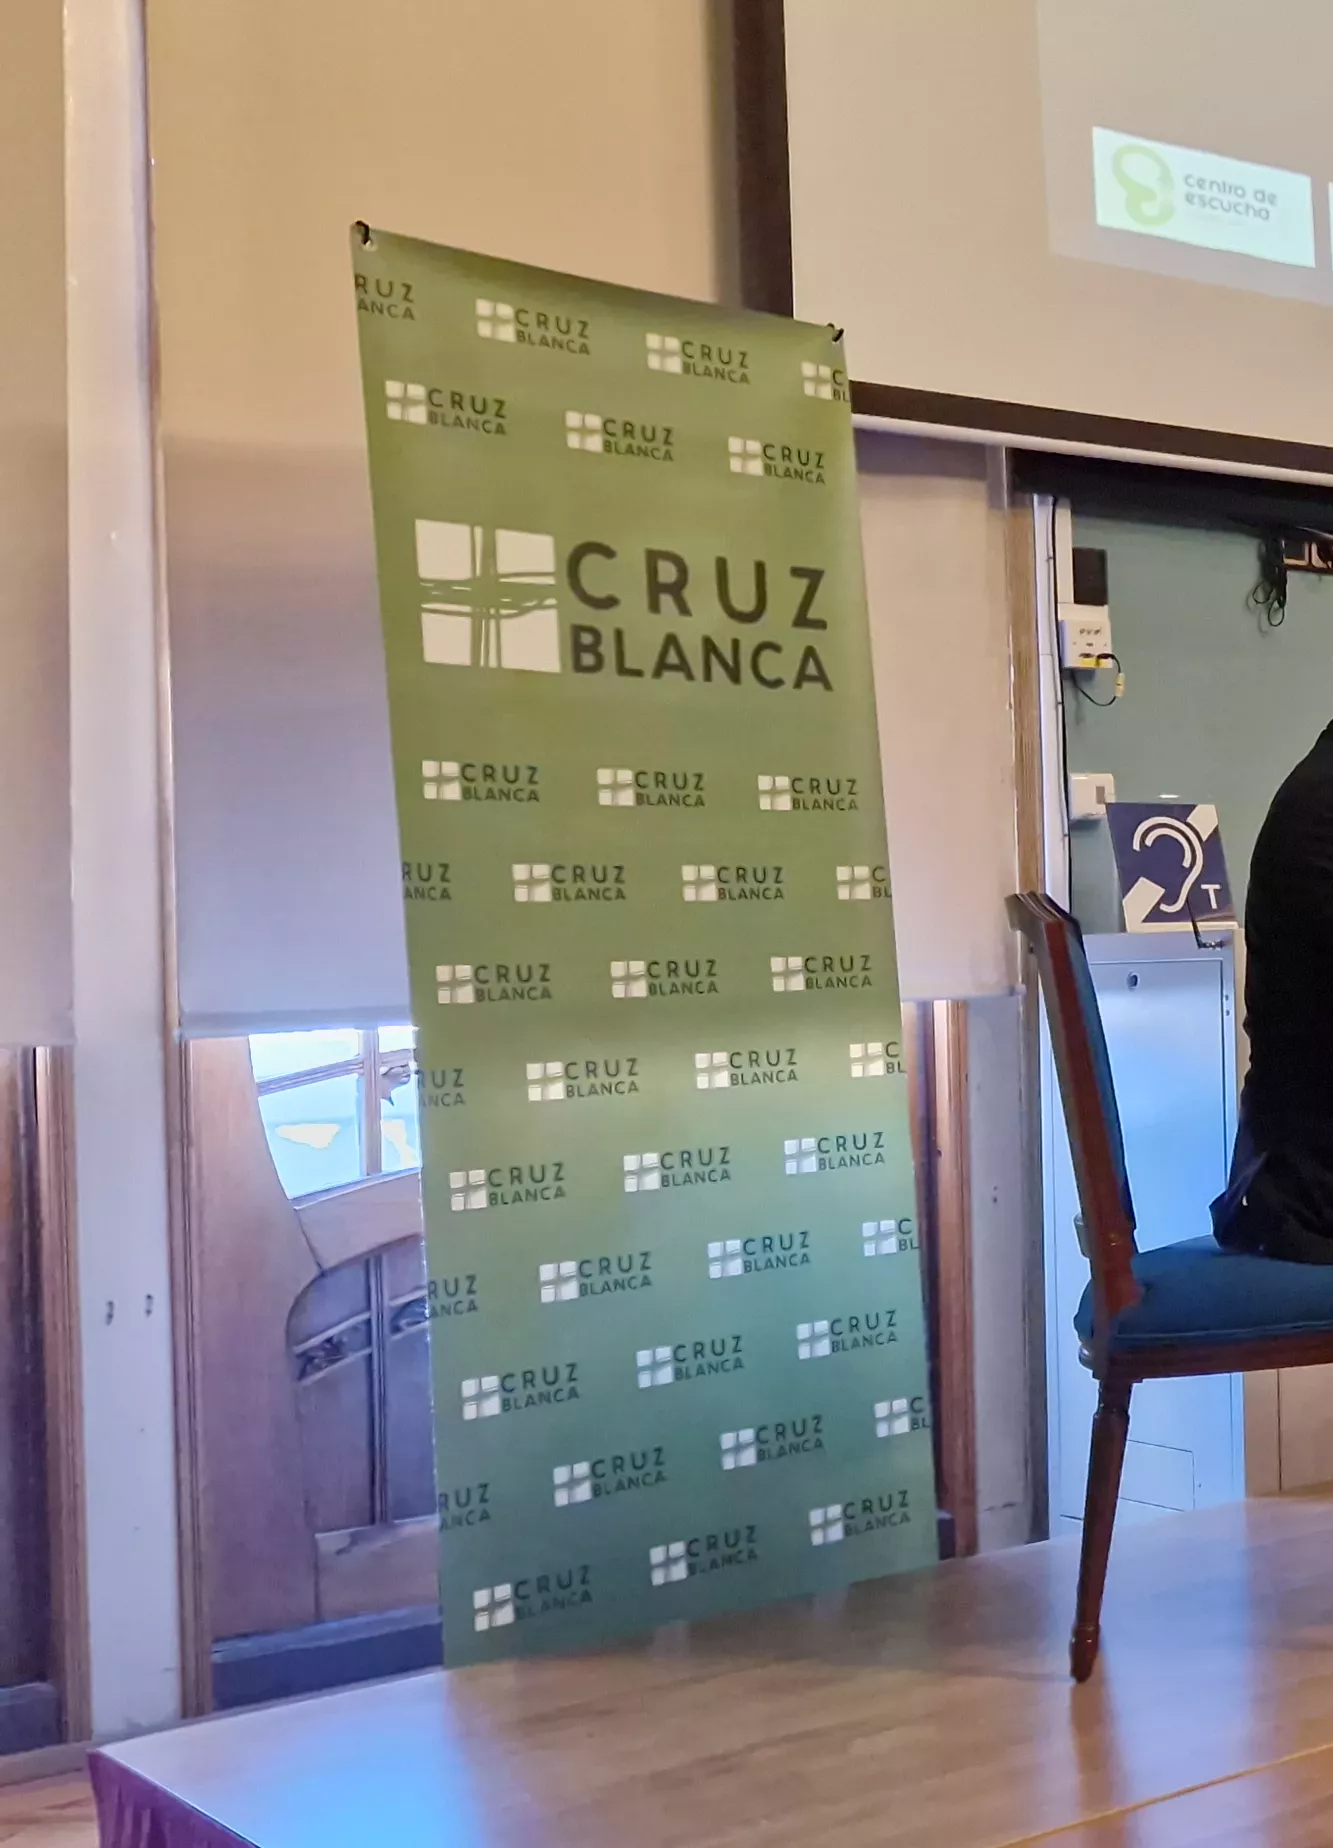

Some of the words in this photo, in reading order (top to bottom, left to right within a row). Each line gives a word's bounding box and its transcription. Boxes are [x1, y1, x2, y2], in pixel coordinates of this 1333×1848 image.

[1184, 192, 1271, 222] escucha
[355, 274, 414, 303] RUZ
[357, 298, 415, 320] ANCA
[515, 308, 589, 338] CRUZ
[516, 330, 590, 355] BLANCA
[681, 341, 749, 369] CRUZ
[682, 361, 750, 384] BLANCA
[428, 388, 507, 419] CRUZ
[428, 411, 507, 435] BLANCA
[602, 418, 674, 446] CRUZ
[603, 439, 674, 462] BLANCA
[762, 443, 825, 468] CRUZ
[763, 463, 825, 485] BLANCA
[566, 541, 828, 630] CRUZ
[570, 623, 834, 691] BLANCA
[461, 764, 539, 785] CRUZ
[635, 771, 704, 791] CRUZ
[462, 786, 540, 802] BLANCA
[791, 778, 858, 796] CRUZ
[635, 792, 705, 807] BLANCA
[791, 797, 858, 811] BLANCA
[402, 862, 451, 883] RUZ
[550, 865, 625, 884] CRUZ
[717, 866, 783, 884] CRUZ
[404, 886, 451, 900] ANCA
[551, 887, 625, 901] BLANCA
[717, 886, 783, 901] BLANCA
[1201, 884, 1221, 909] T
[474, 964, 551, 984] CRUZ
[647, 960, 717, 980] CRUZ
[804, 955, 872, 974] CRUZ
[474, 986, 552, 1001] BLANCA
[647, 981, 718, 996] BLANCA
[805, 975, 872, 991] BLANCA
[564, 1058, 638, 1081] CRUZ
[729, 1049, 797, 1069] CRUZ
[565, 1080, 639, 1098] BLANCA
[730, 1068, 797, 1087] BLANCA
[817, 1131, 884, 1155] CRUZ
[660, 1146, 730, 1171] CRUZ
[818, 1152, 884, 1170] BLANCA
[487, 1163, 565, 1188] CRUZ
[661, 1168, 731, 1189] BLANCA
[488, 1185, 566, 1207] BLANCA
[742, 1232, 809, 1256] CRUZ
[578, 1251, 651, 1279] CRUZ
[743, 1252, 810, 1274] BLANCA
[427, 1274, 477, 1301] RUZ
[579, 1274, 652, 1298] BLANCA
[428, 1299, 478, 1319] ANCA
[830, 1310, 897, 1336] CRUZ
[673, 1336, 743, 1364] CRUZ
[831, 1332, 897, 1353] BLANCA
[501, 1363, 578, 1393] CRUZ
[674, 1357, 744, 1382] BLANCA
[502, 1387, 579, 1413] BLANCA
[755, 1415, 823, 1445] CRUZ
[757, 1438, 824, 1463] BLANCA
[591, 1448, 665, 1479] CRUZ
[593, 1471, 666, 1497] BLANCA
[439, 1483, 490, 1511] RUZ
[842, 1490, 909, 1521] CRUZ
[439, 1507, 491, 1532] ANCA
[844, 1513, 910, 1538] BLANCA
[686, 1525, 757, 1558] CRUZ
[688, 1549, 757, 1574] BLANCA
[513, 1565, 591, 1601] CRUZ
[515, 1589, 592, 1621] BLANCA
